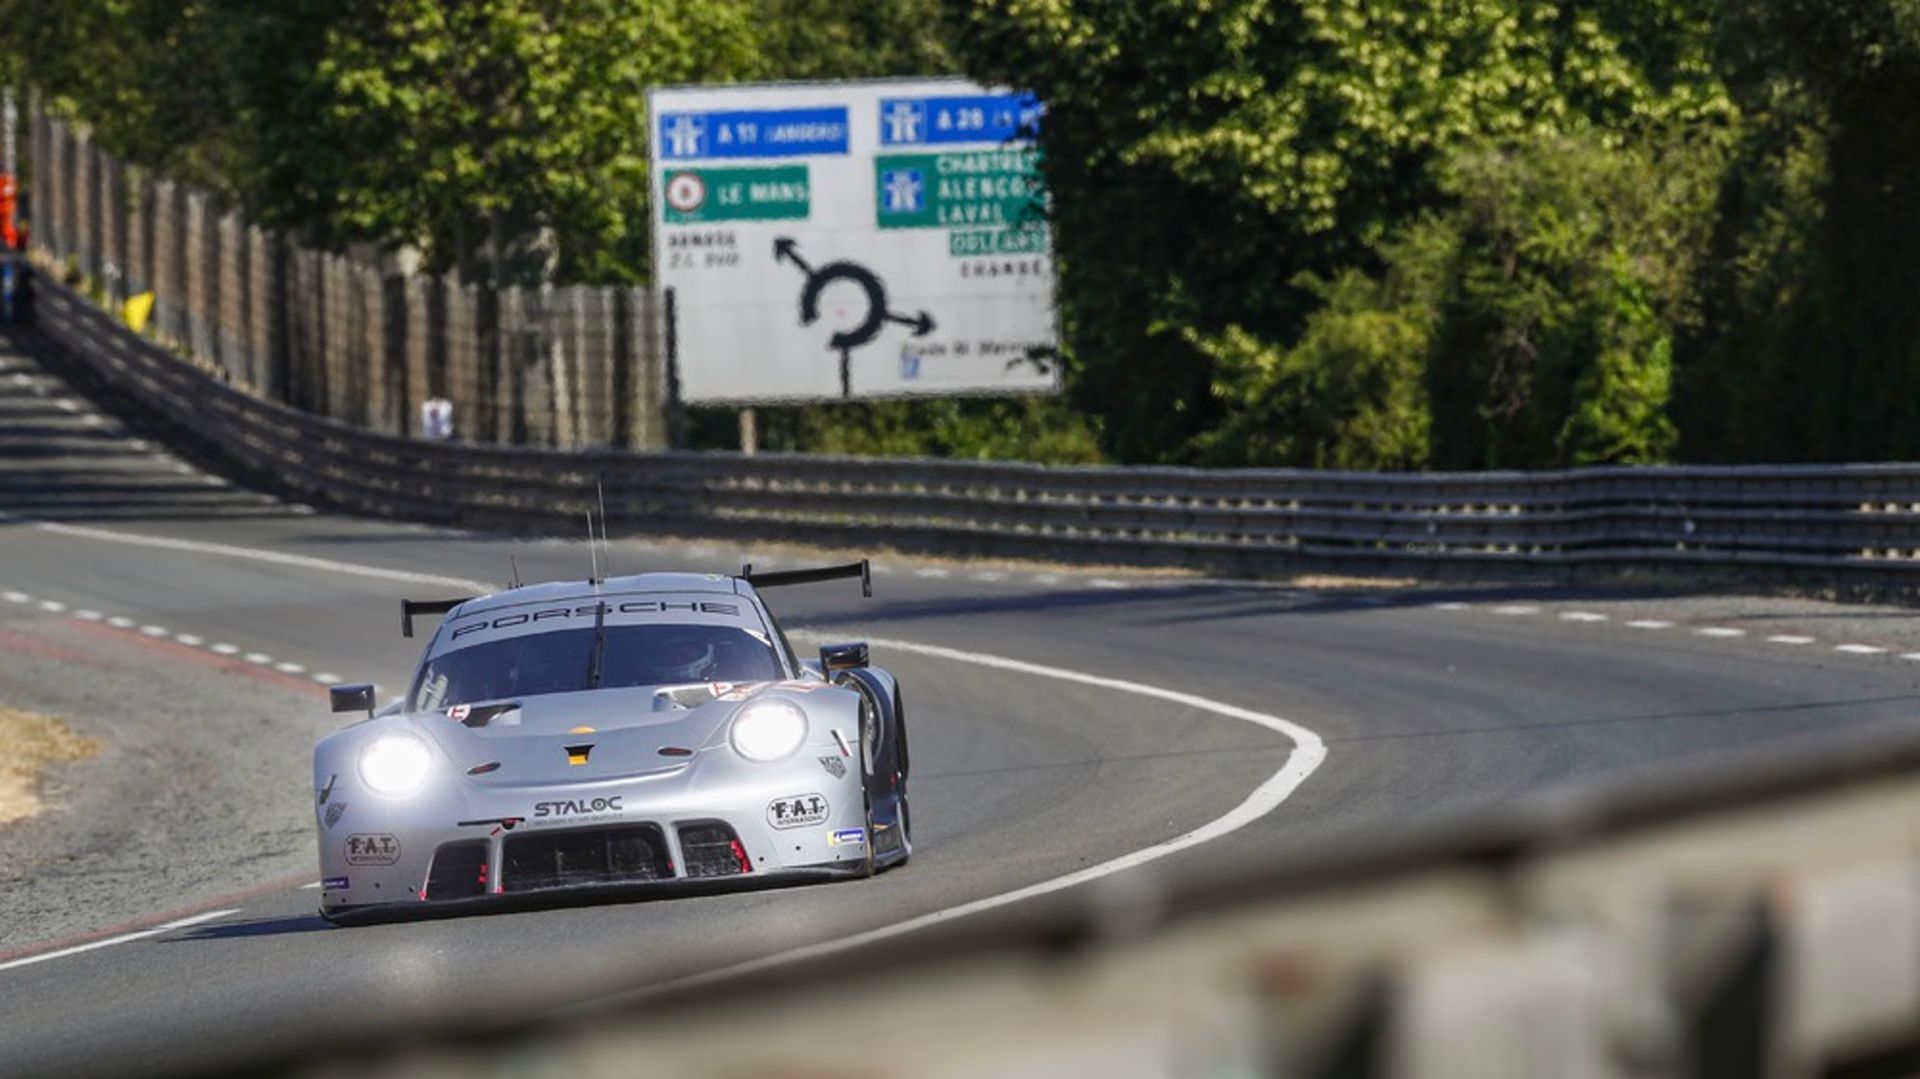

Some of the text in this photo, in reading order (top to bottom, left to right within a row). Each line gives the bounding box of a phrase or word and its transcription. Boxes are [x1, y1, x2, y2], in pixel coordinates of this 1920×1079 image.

[936, 110, 951, 130] A
[717, 125, 732, 144] A
[452, 602, 740, 640] PORSCHE
[534, 796, 623, 817] STALOC
